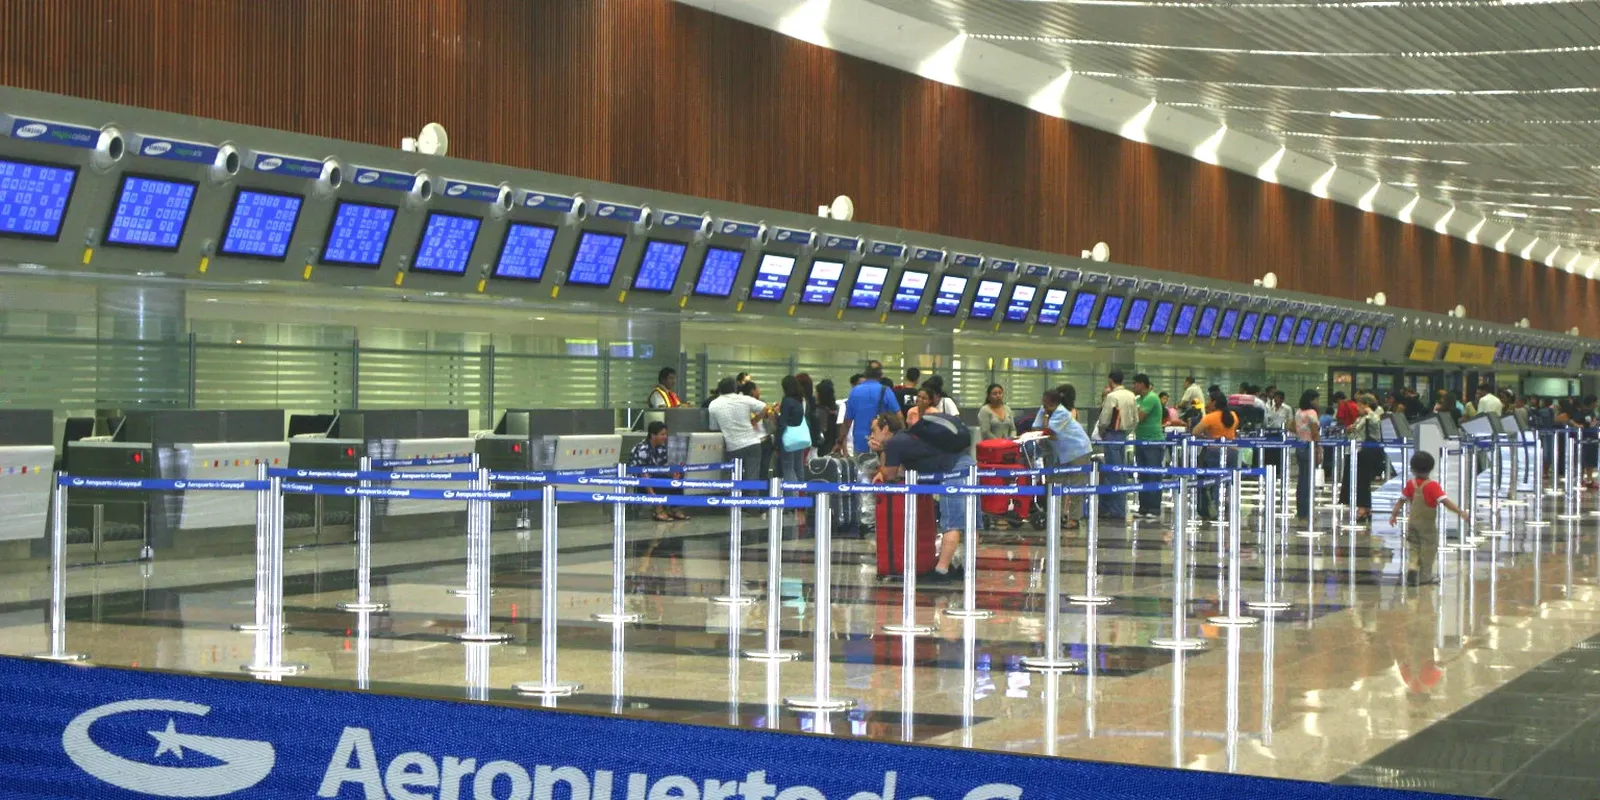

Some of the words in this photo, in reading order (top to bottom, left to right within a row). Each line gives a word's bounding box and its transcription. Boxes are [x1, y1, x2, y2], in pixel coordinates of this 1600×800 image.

[21, 126, 44, 134] SAMSUNG
[118, 480, 142, 488] Guayaquil
[221, 482, 244, 490] Guayaquil
[317, 727, 826, 800] Aeropue
